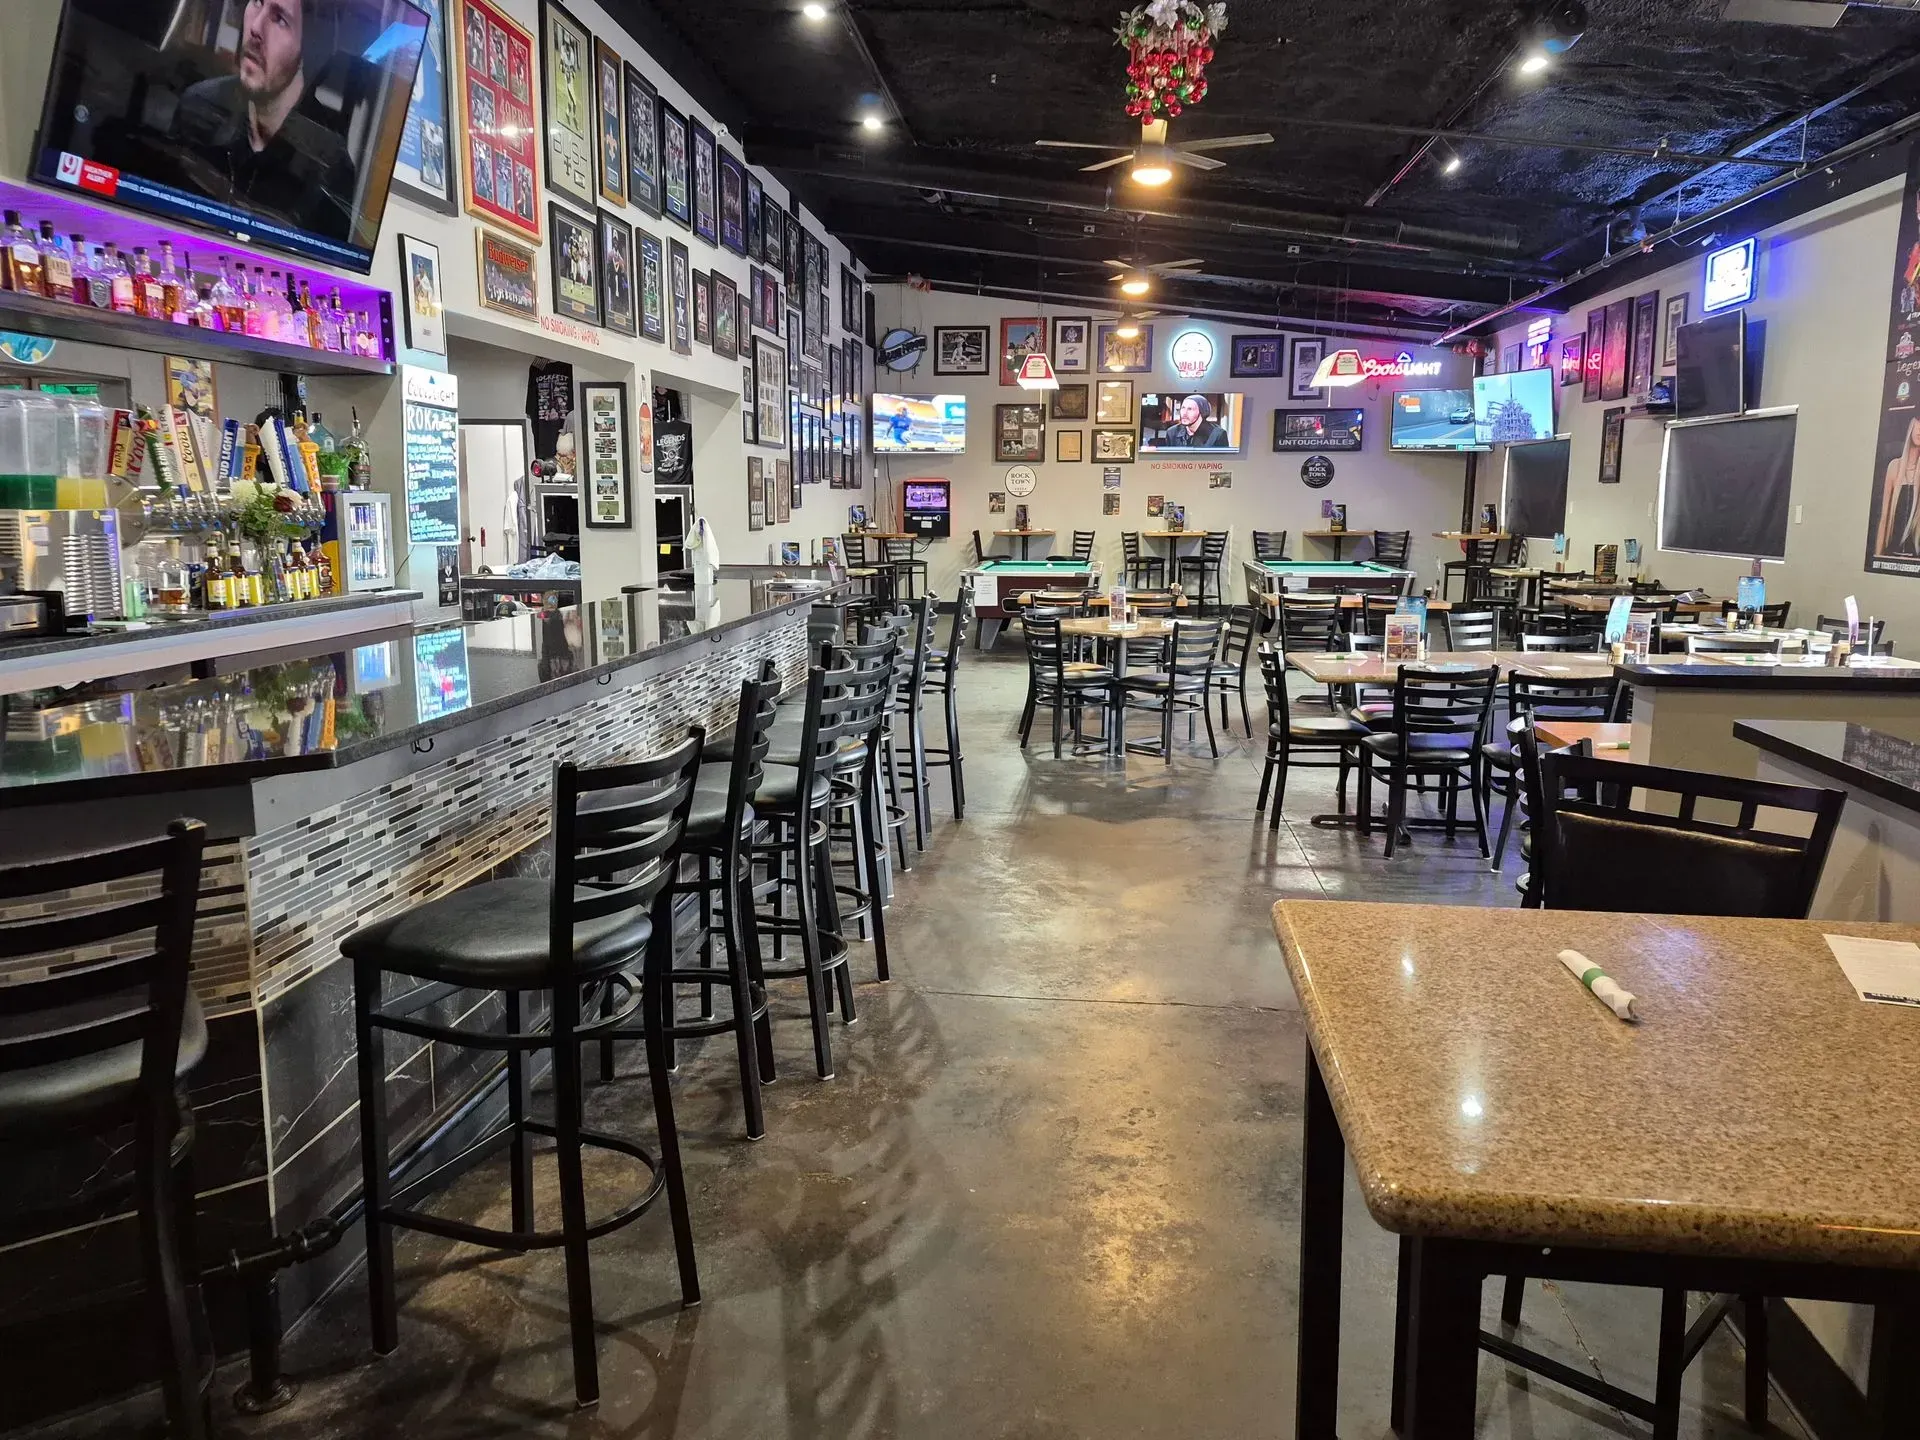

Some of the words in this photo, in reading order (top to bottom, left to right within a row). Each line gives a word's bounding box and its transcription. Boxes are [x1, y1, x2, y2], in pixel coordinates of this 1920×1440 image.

[486, 239, 530, 273] Budweiser
[1363, 358, 1404, 378] Coors
[178, 430, 195, 465] Coors
[223, 429, 235, 461] LIGHT
[656, 434, 686, 446] LEGENDS
[1150, 462, 1161, 470] NO
[1161, 462, 1193, 470] SMOKING
[1198, 462, 1223, 470] VAPING
